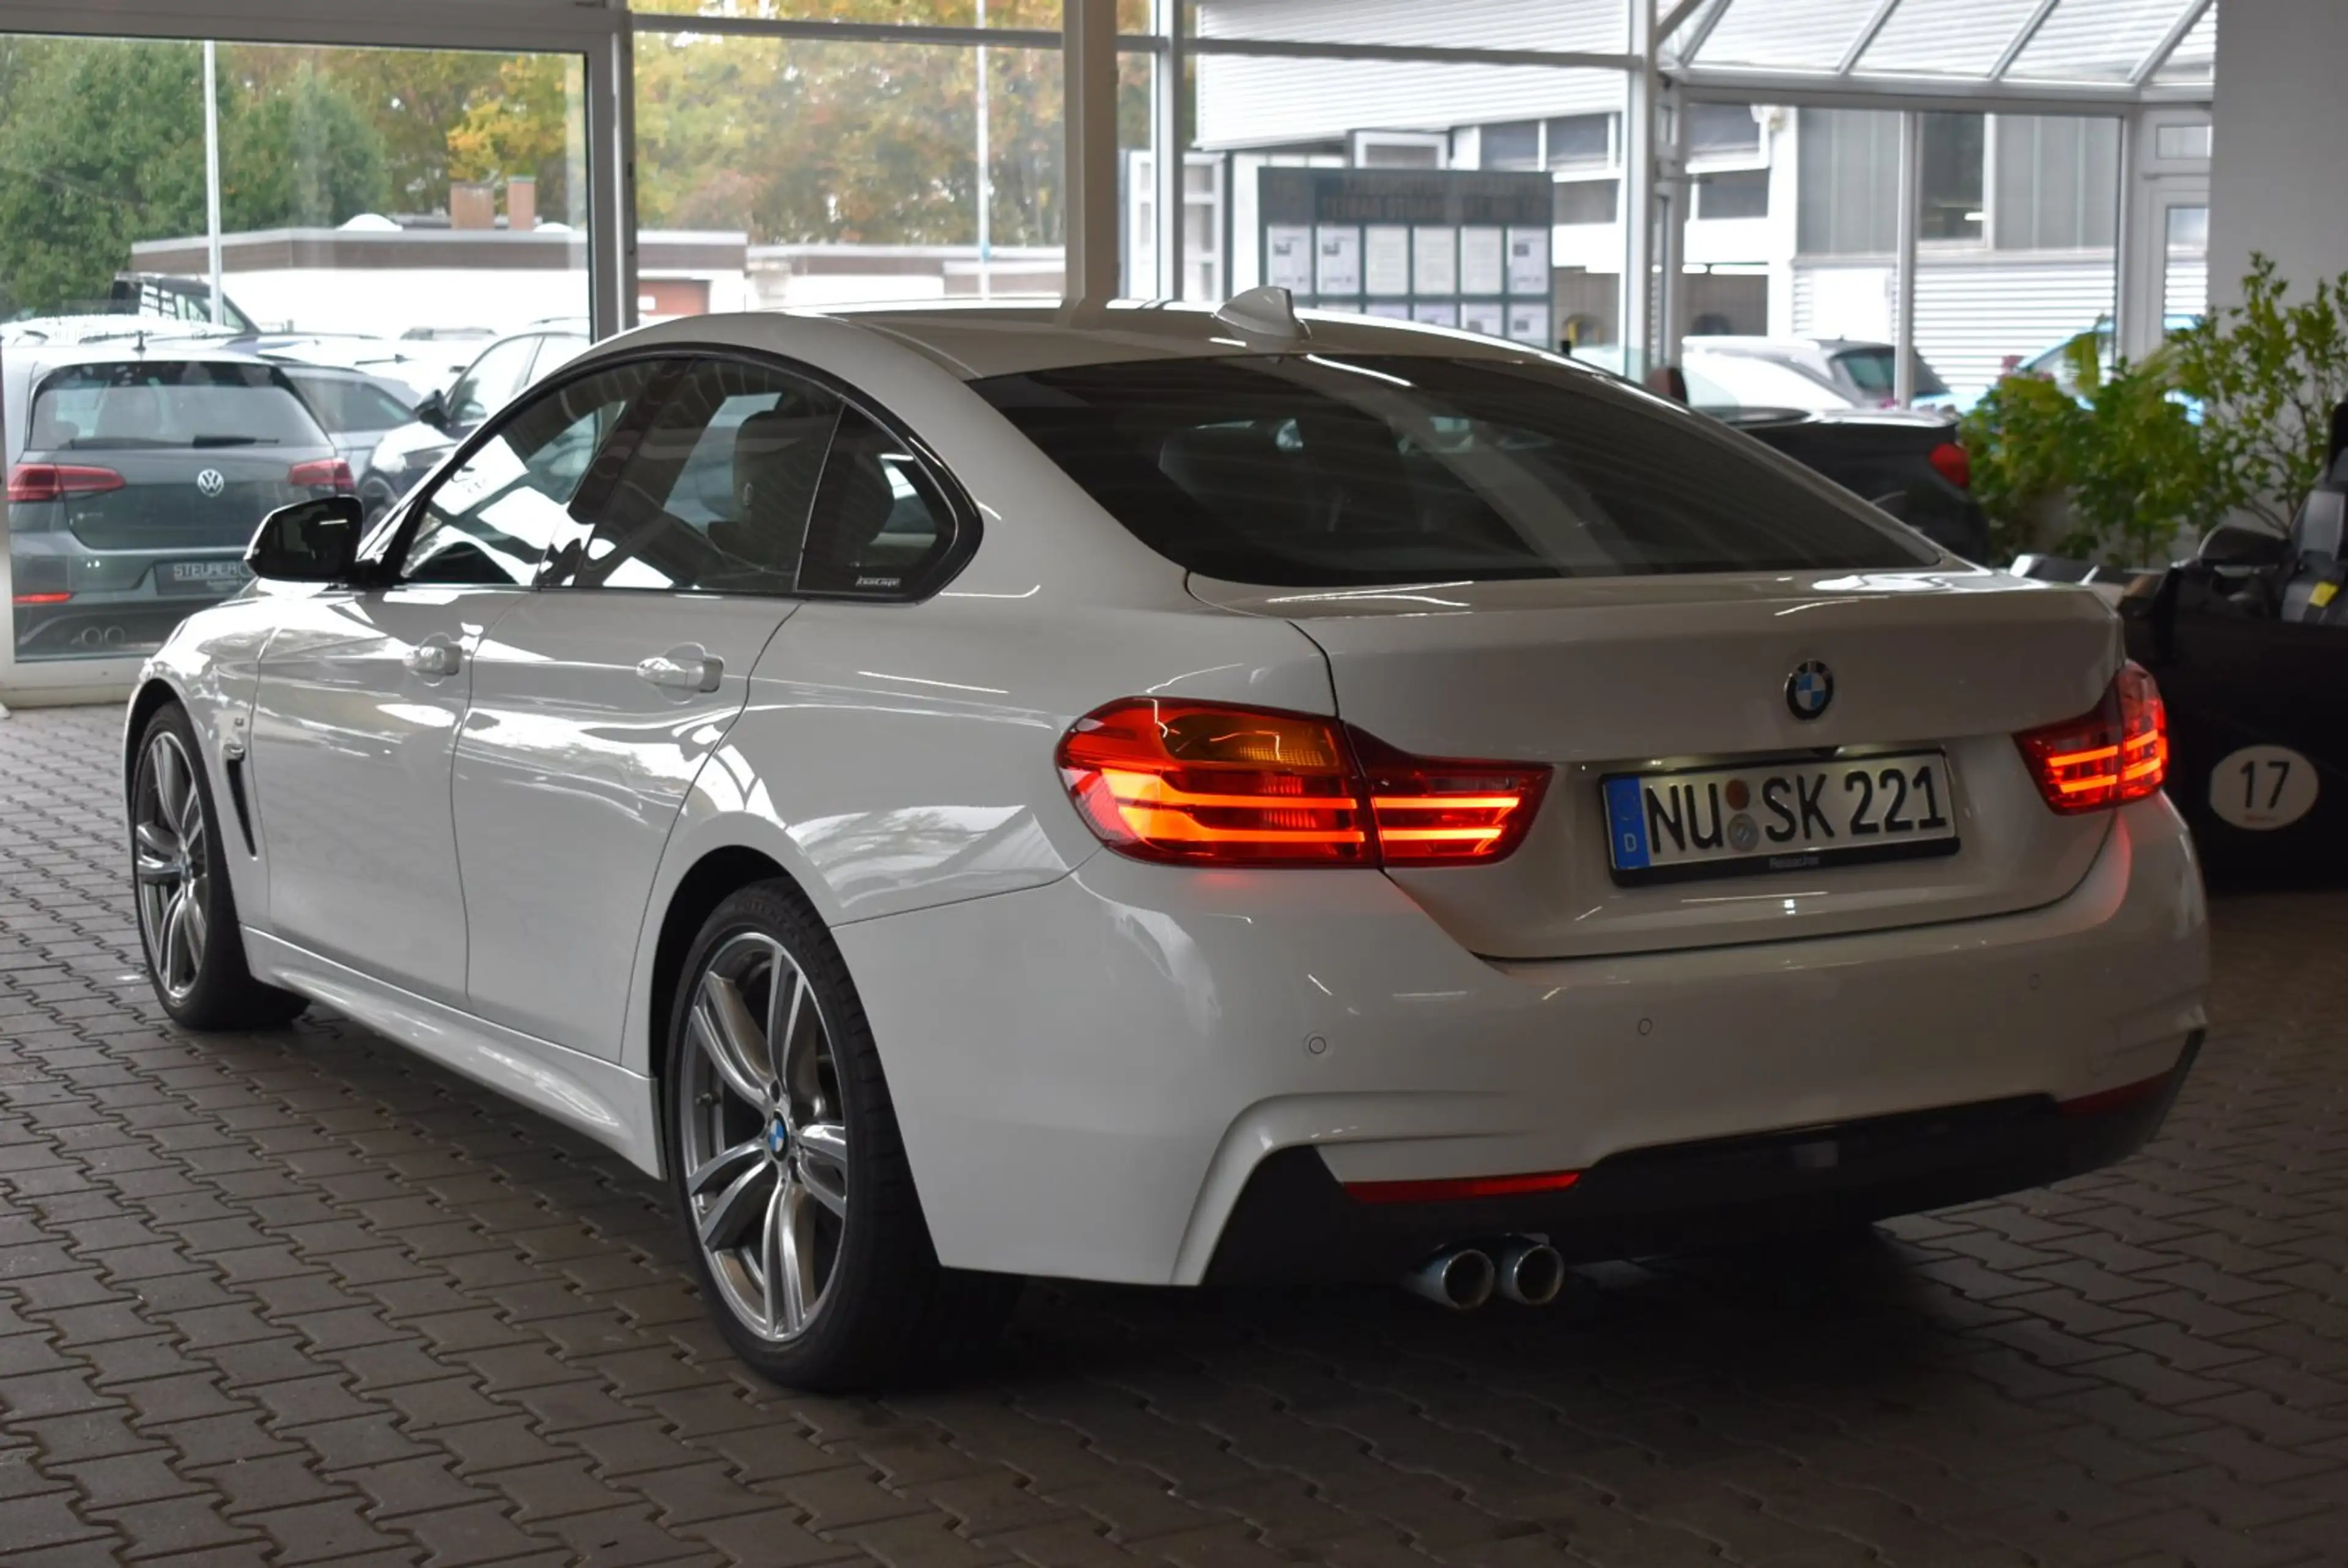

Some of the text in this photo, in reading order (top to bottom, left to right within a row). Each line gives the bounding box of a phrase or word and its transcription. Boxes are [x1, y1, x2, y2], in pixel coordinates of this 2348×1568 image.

[1645, 766, 1946, 853] NU SK 221
[2239, 760, 2290, 810] 17
[1623, 832, 1637, 853] D
